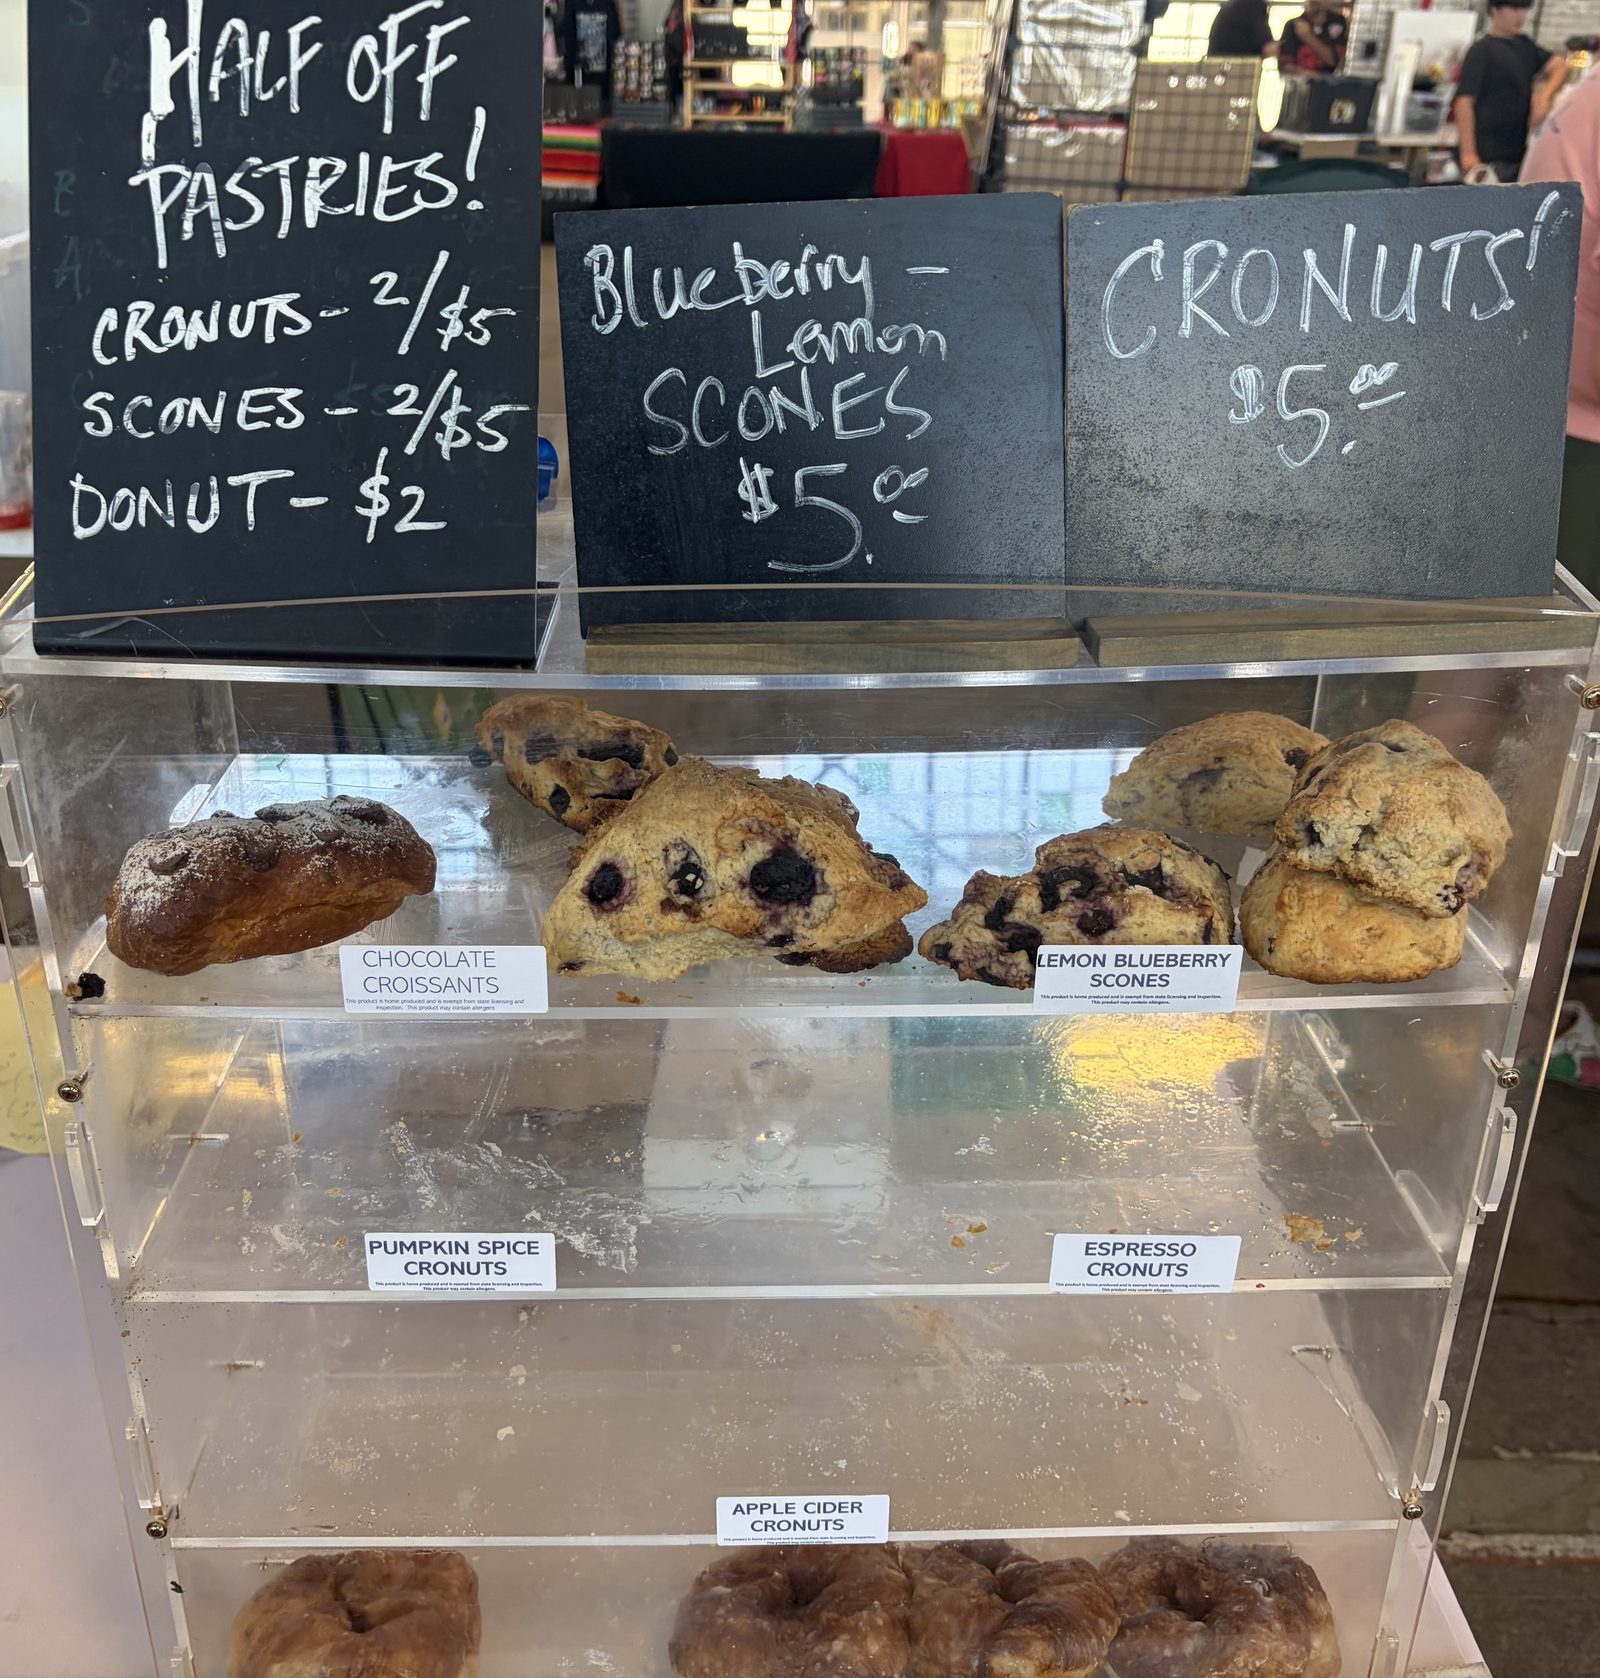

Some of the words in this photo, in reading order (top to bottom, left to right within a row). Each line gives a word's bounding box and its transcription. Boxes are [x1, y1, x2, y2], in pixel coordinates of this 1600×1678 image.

[143, 0, 324, 148] HALF
[346, 0, 471, 135] OFF
[128, 105, 486, 269] PASTRIES!
[584, 241, 875, 334] Blueberry
[751, 310, 948, 378] Lemon
[83, 386, 305, 438] SCONES
[643, 366, 933, 456] SCONES
[354, 447, 448, 543] $2
[362, 950, 497, 968] CHOCOLATE
[1037, 953, 1107, 968] LEMON
[1114, 953, 1232, 968] BLUEBERRY
[363, 976, 500, 994] CROISSANTS
[1090, 973, 1170, 988] SCONES
[369, 1240, 470, 1255] PUMPKIN
[478, 1240, 540, 1255] SPICE
[1084, 1241, 1197, 1257] ESPRESSO
[404, 1261, 508, 1276] CRONUTS
[1087, 1262, 1189, 1277] CRONUTS
[732, 1502, 797, 1515] APPLE
[803, 1501, 863, 1514] CIDER
[750, 1518, 845, 1532] CRONUTS
